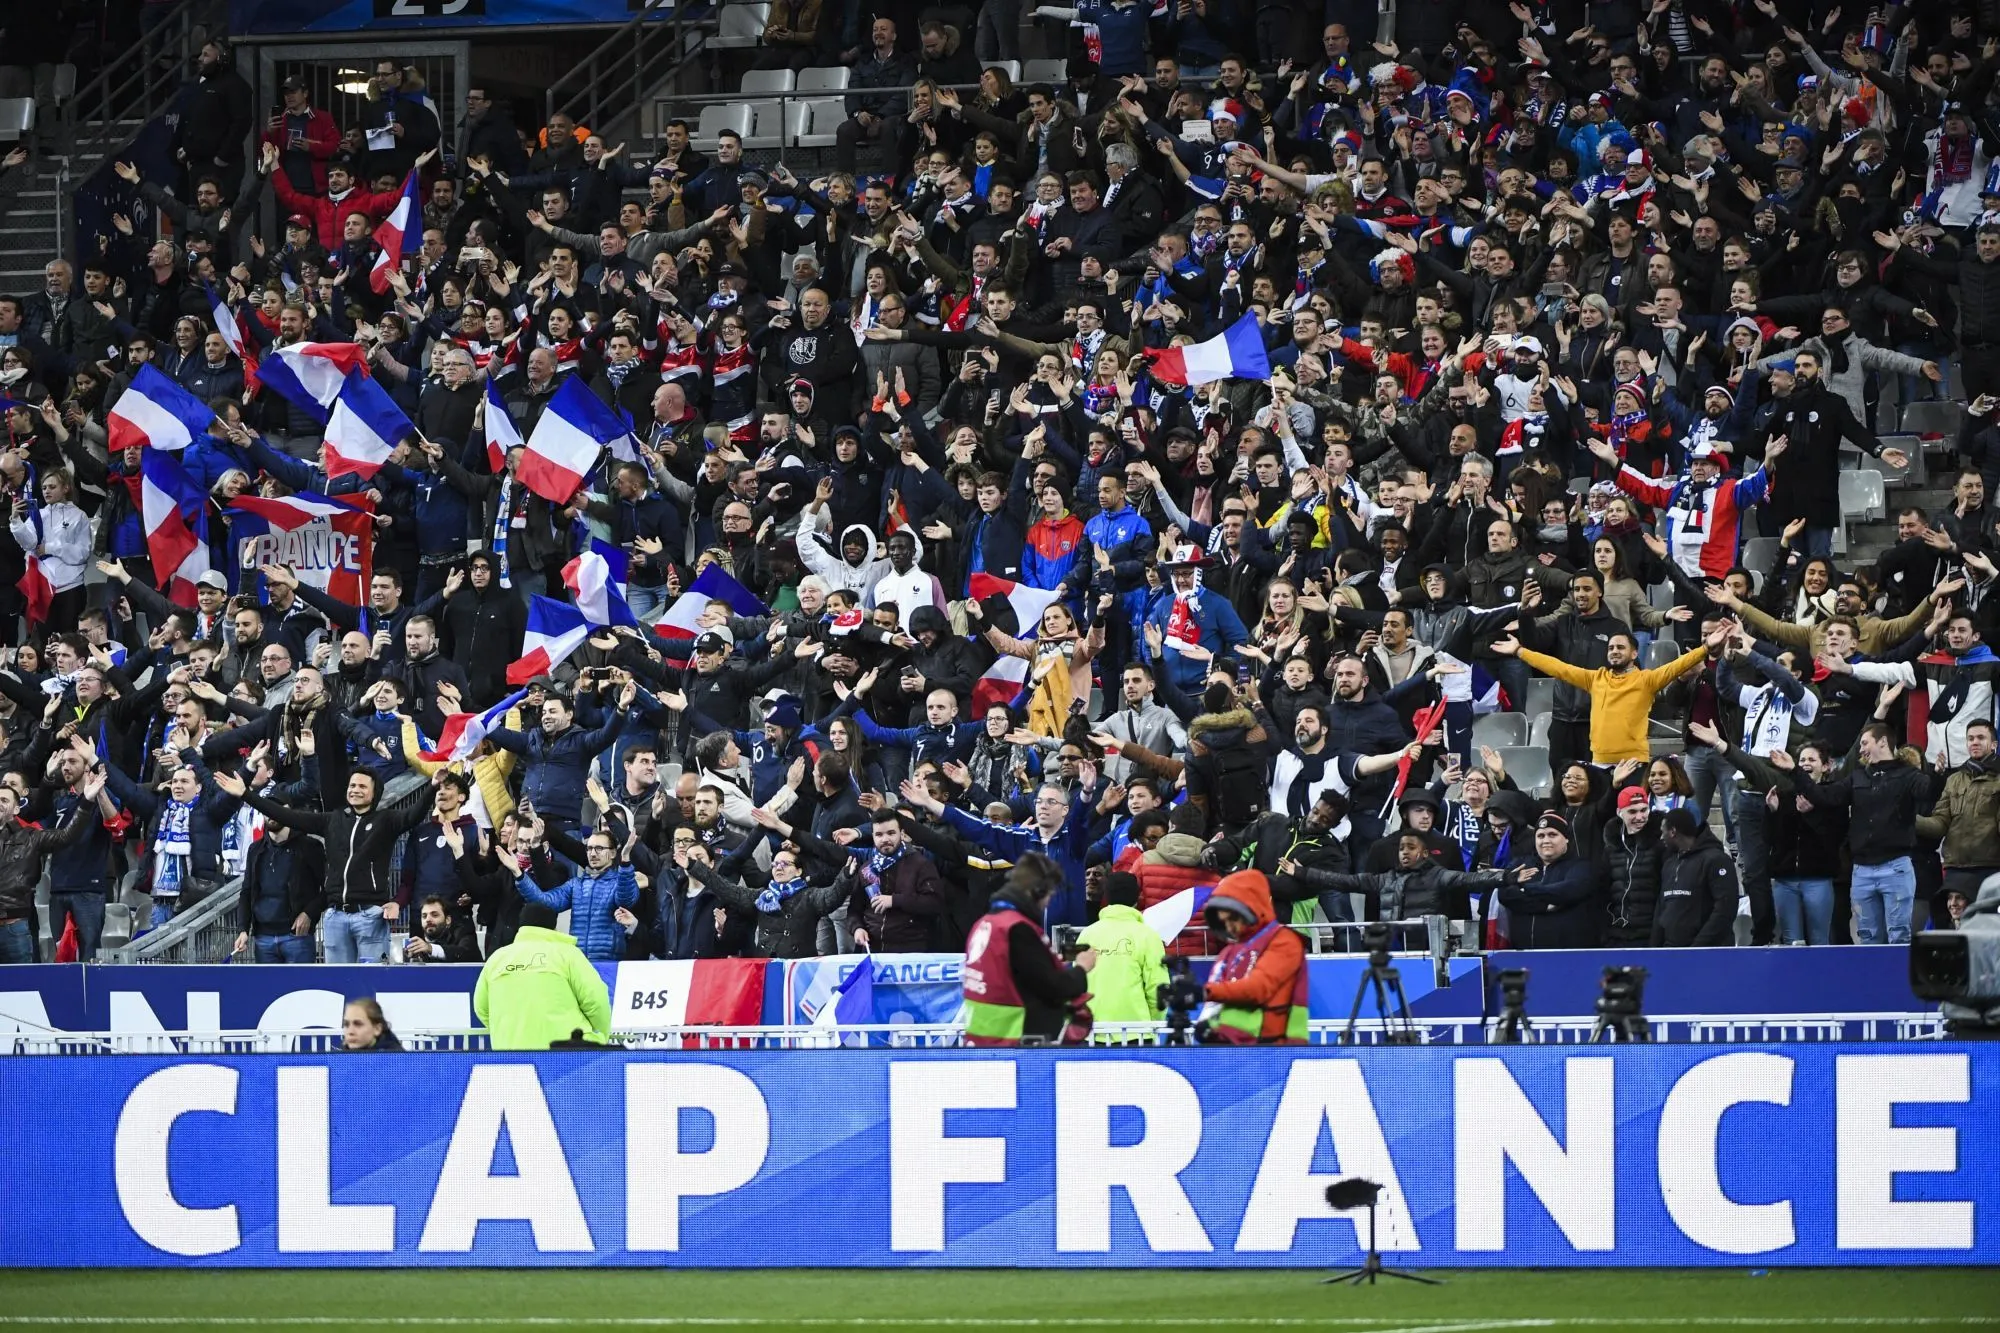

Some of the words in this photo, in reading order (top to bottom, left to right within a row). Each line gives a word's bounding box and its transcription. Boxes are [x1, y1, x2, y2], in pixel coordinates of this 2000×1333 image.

[1204, 155, 1213, 170] 9
[1506, 392, 1516, 408] 6
[425, 487, 432, 503] 7
[916, 743, 925, 762] 7
[631, 989, 669, 1010] B4S
[115, 1060, 770, 1256] CLAP
[889, 1052, 1974, 1255] FRANCE
